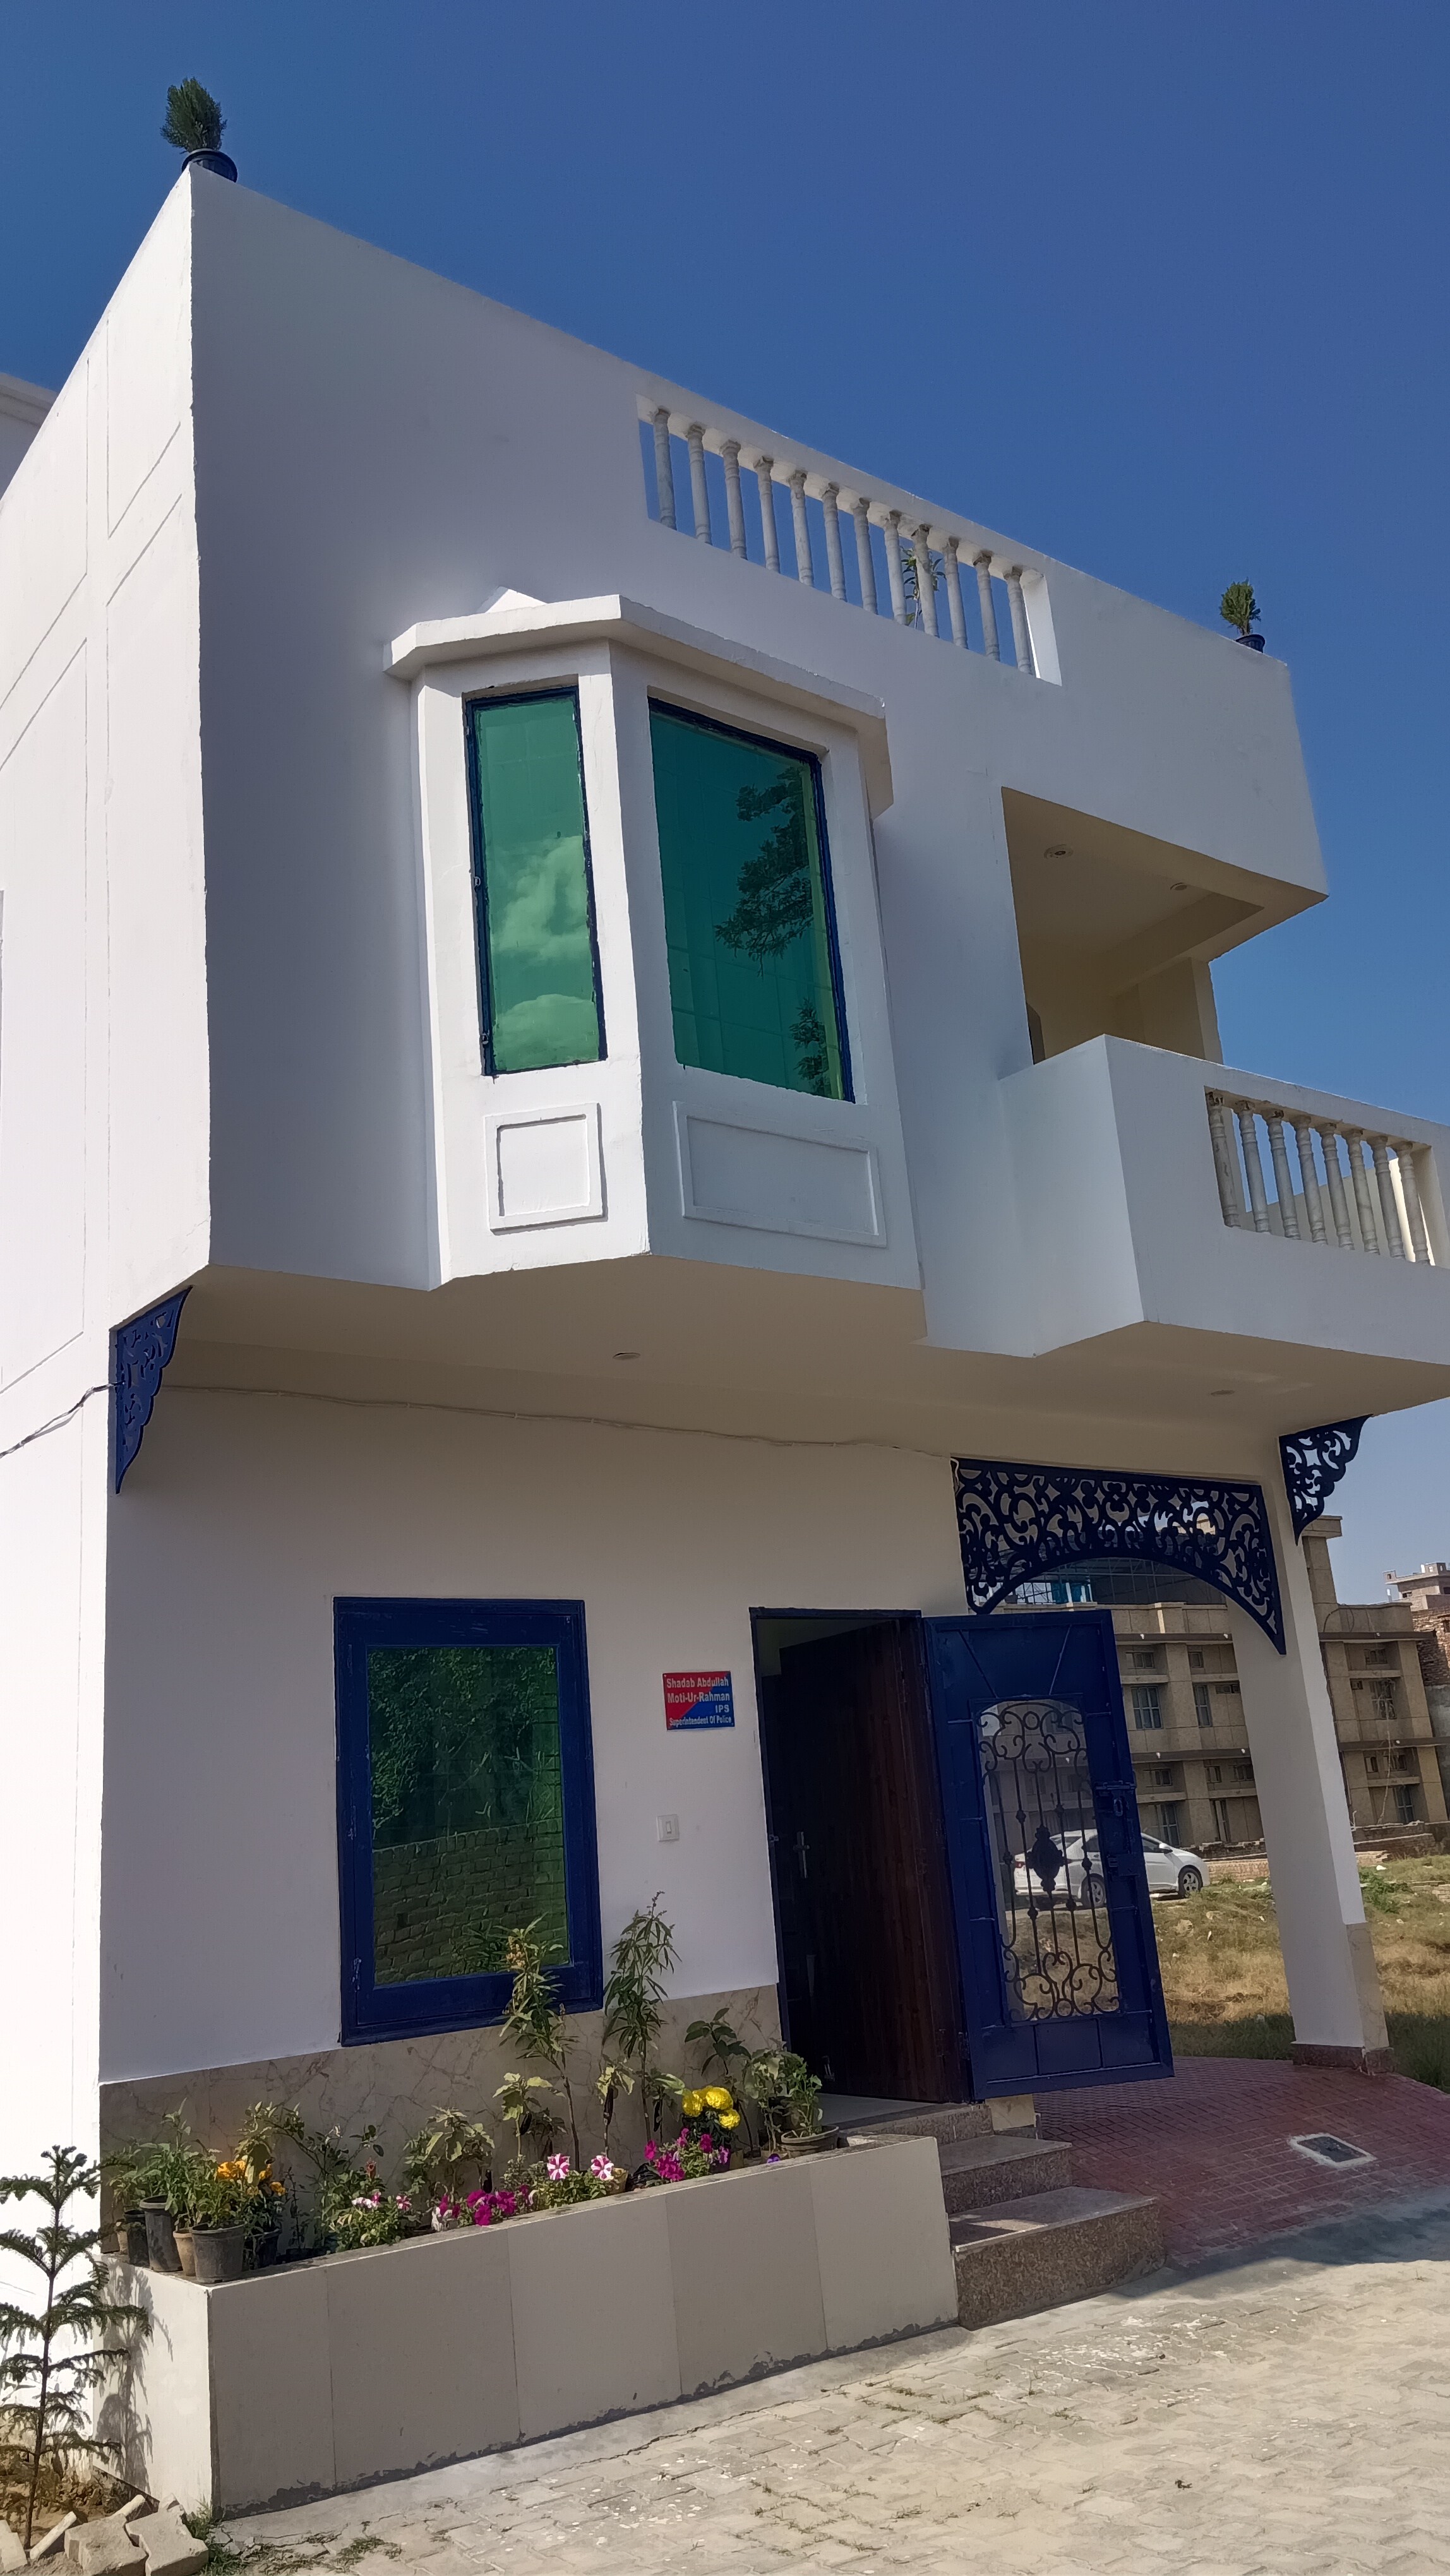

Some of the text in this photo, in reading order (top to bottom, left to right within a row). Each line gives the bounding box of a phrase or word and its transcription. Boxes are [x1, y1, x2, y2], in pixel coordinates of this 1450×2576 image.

[666, 1676, 729, 1688] Shadab Abdullah
[668, 1691, 730, 1703] Moti-Ur-Rahman
[716, 1705, 729, 1713] IPS
[709, 1715, 716, 1724] Of
[716, 1715, 732, 1724] Police
